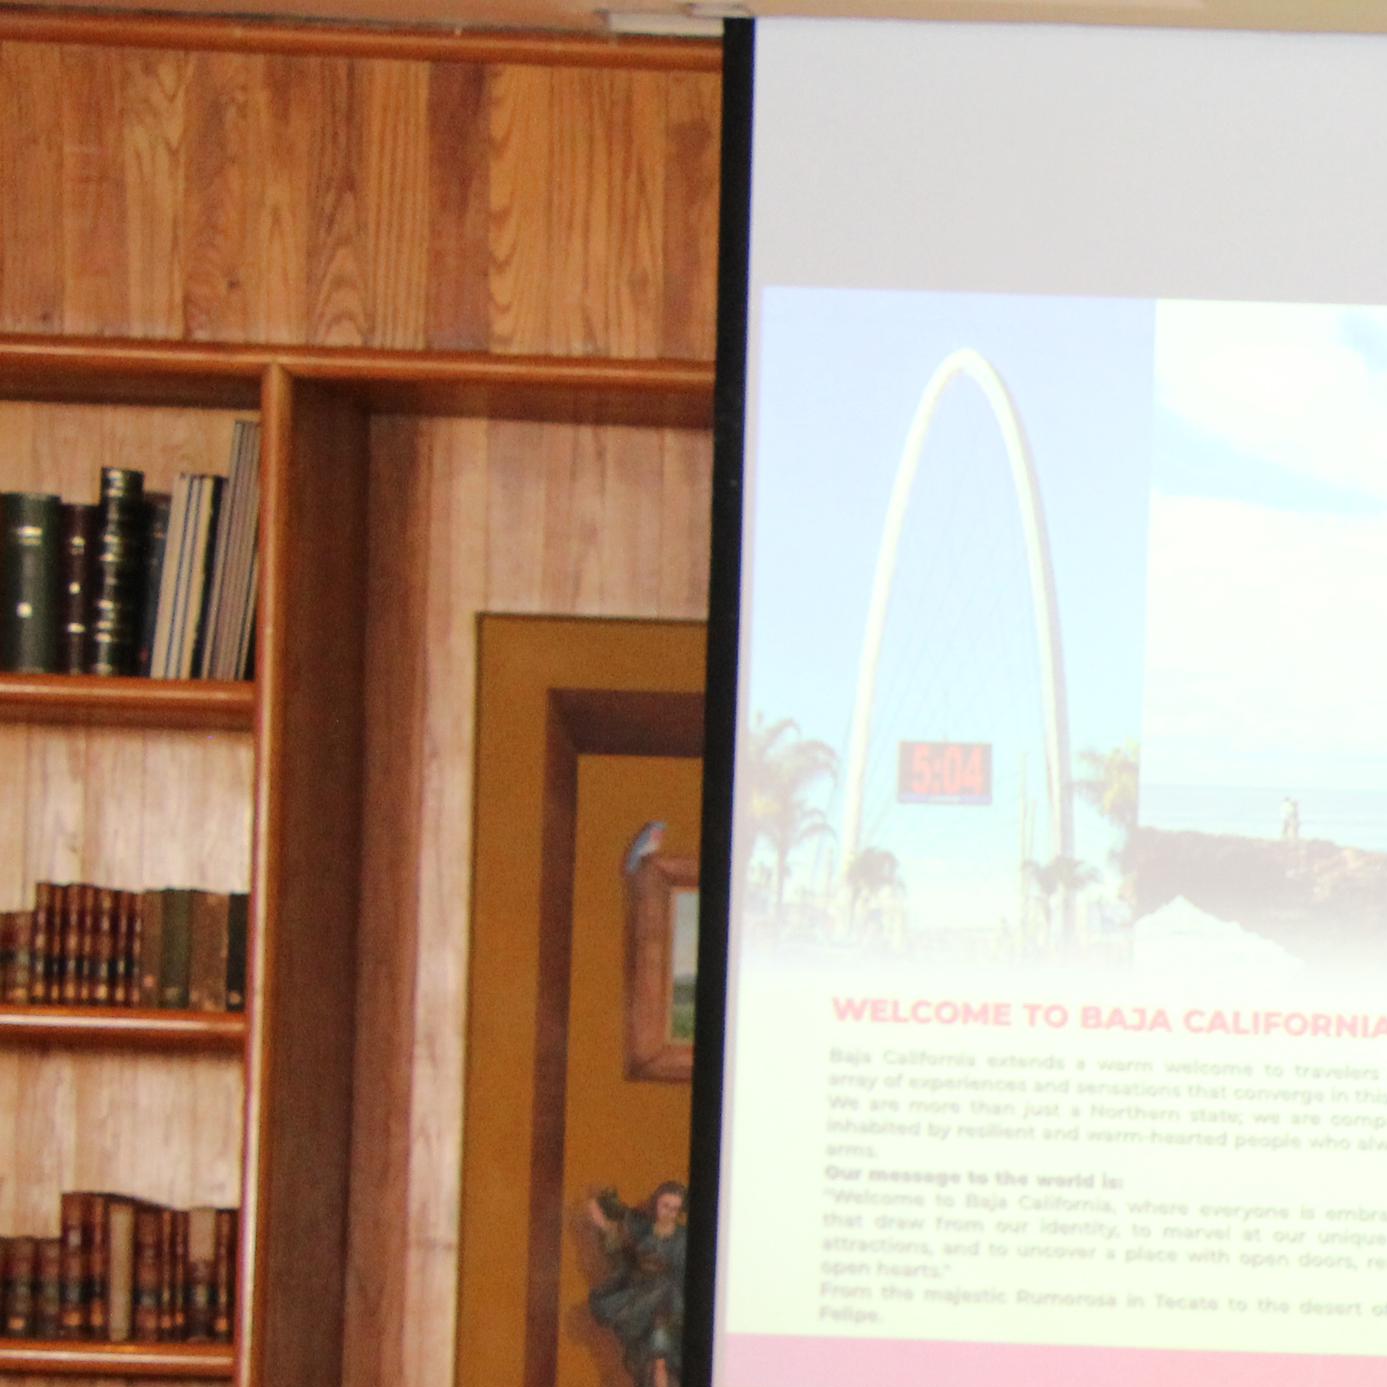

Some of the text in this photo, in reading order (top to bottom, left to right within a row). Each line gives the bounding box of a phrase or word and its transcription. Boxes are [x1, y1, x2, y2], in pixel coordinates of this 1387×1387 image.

[833, 997, 1012, 1028] WELCOME
[1023, 1002, 1070, 1030] TO
[1080, 1004, 1173, 1033] BAJA
[827, 1046, 873, 1069] Baja
[882, 1048, 977, 1068] California
[985, 1051, 1066, 1070] extends
[1096, 1059, 1154, 1073] warm
[1164, 1057, 1255, 1076] welcome
[1293, 1061, 1381, 1080] travelers
[826, 1074, 879, 1092] array
[907, 1071, 1028, 1097] experiences
[1075, 1076, 1182, 1097] sensations
[1186, 1080, 1228, 1098] that
[1232, 1086, 1326, 1106] converge
[908, 1100, 961, 1113] more
[969, 1097, 1016, 1115] than
[1022, 1099, 1060, 1121] just
[1089, 1101, 1181, 1120] Northern
[1290, 1113, 1322, 1125] are
[825, 1117, 922, 1137] inhabited
[956, 1121, 1036, 1140] resilient
[1042, 1123, 1080, 1142] and
[1086, 1125, 1229, 1146] warm-hearted
[1233, 1129, 1302, 1153] people
[1308, 1131, 1352, 1150] who
[822, 1163, 863, 1181] Our
[867, 1169, 962, 1189] message
[1035, 1170, 1096, 1189] world
[964, 1190, 1009, 1213] Baja
[1125, 1195, 1190, 1215] where
[1197, 1203, 1291, 1223] everyone
[820, 1209, 863, 1227] that
[873, 1211, 926, 1229] draw
[934, 1213, 985, 1231] from
[994, 1220, 1030, 1233] our
[1161, 1221, 1232, 1240] marvel
[1316, 1226, 1387, 1250] unique
[820, 1262, 869, 1280] open
[1016, 1245, 1097, 1260] uncover
[1123, 1244, 1179, 1267] place
[1186, 1246, 1231, 1264] with
[1238, 1252, 1290, 1271] open
[819, 1279, 870, 1298] From
[881, 1282, 914, 1300] the
[924, 1283, 1005, 1308] majestic
[1015, 1286, 1118, 1307] Rumorosa
[1155, 1291, 1219, 1310] Tecate
[1257, 1294, 1290, 1312] the
[1298, 1296, 1362, 1315] desert
